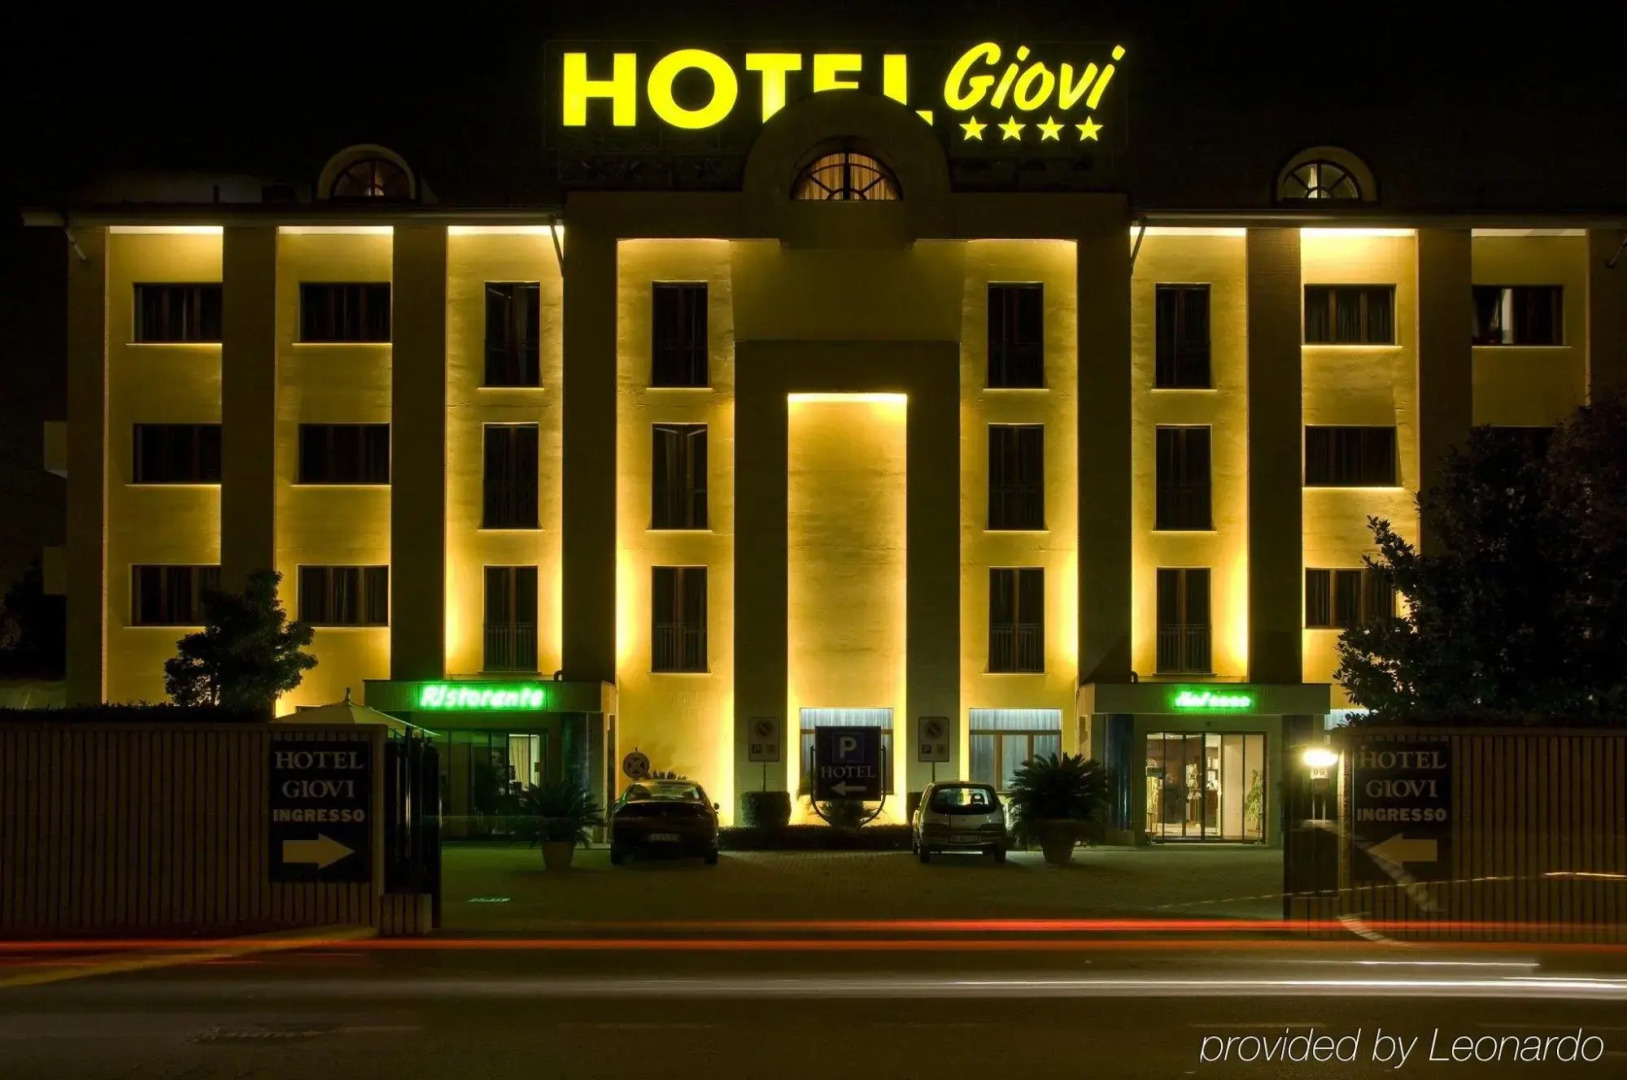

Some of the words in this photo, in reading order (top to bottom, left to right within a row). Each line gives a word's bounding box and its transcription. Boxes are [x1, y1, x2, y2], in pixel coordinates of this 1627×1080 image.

[943, 41, 1126, 112] Giovi
[839, 736, 858, 760] P
[275, 750, 365, 771] HOTEL
[1358, 750, 1448, 770] HOTEL
[820, 765, 876, 779] HOTEL
[281, 779, 357, 799] GIOVI
[1365, 778, 1439, 798] GIOVI
[272, 808, 366, 823] INGRESSO
[1356, 807, 1448, 822] INGRESSO
